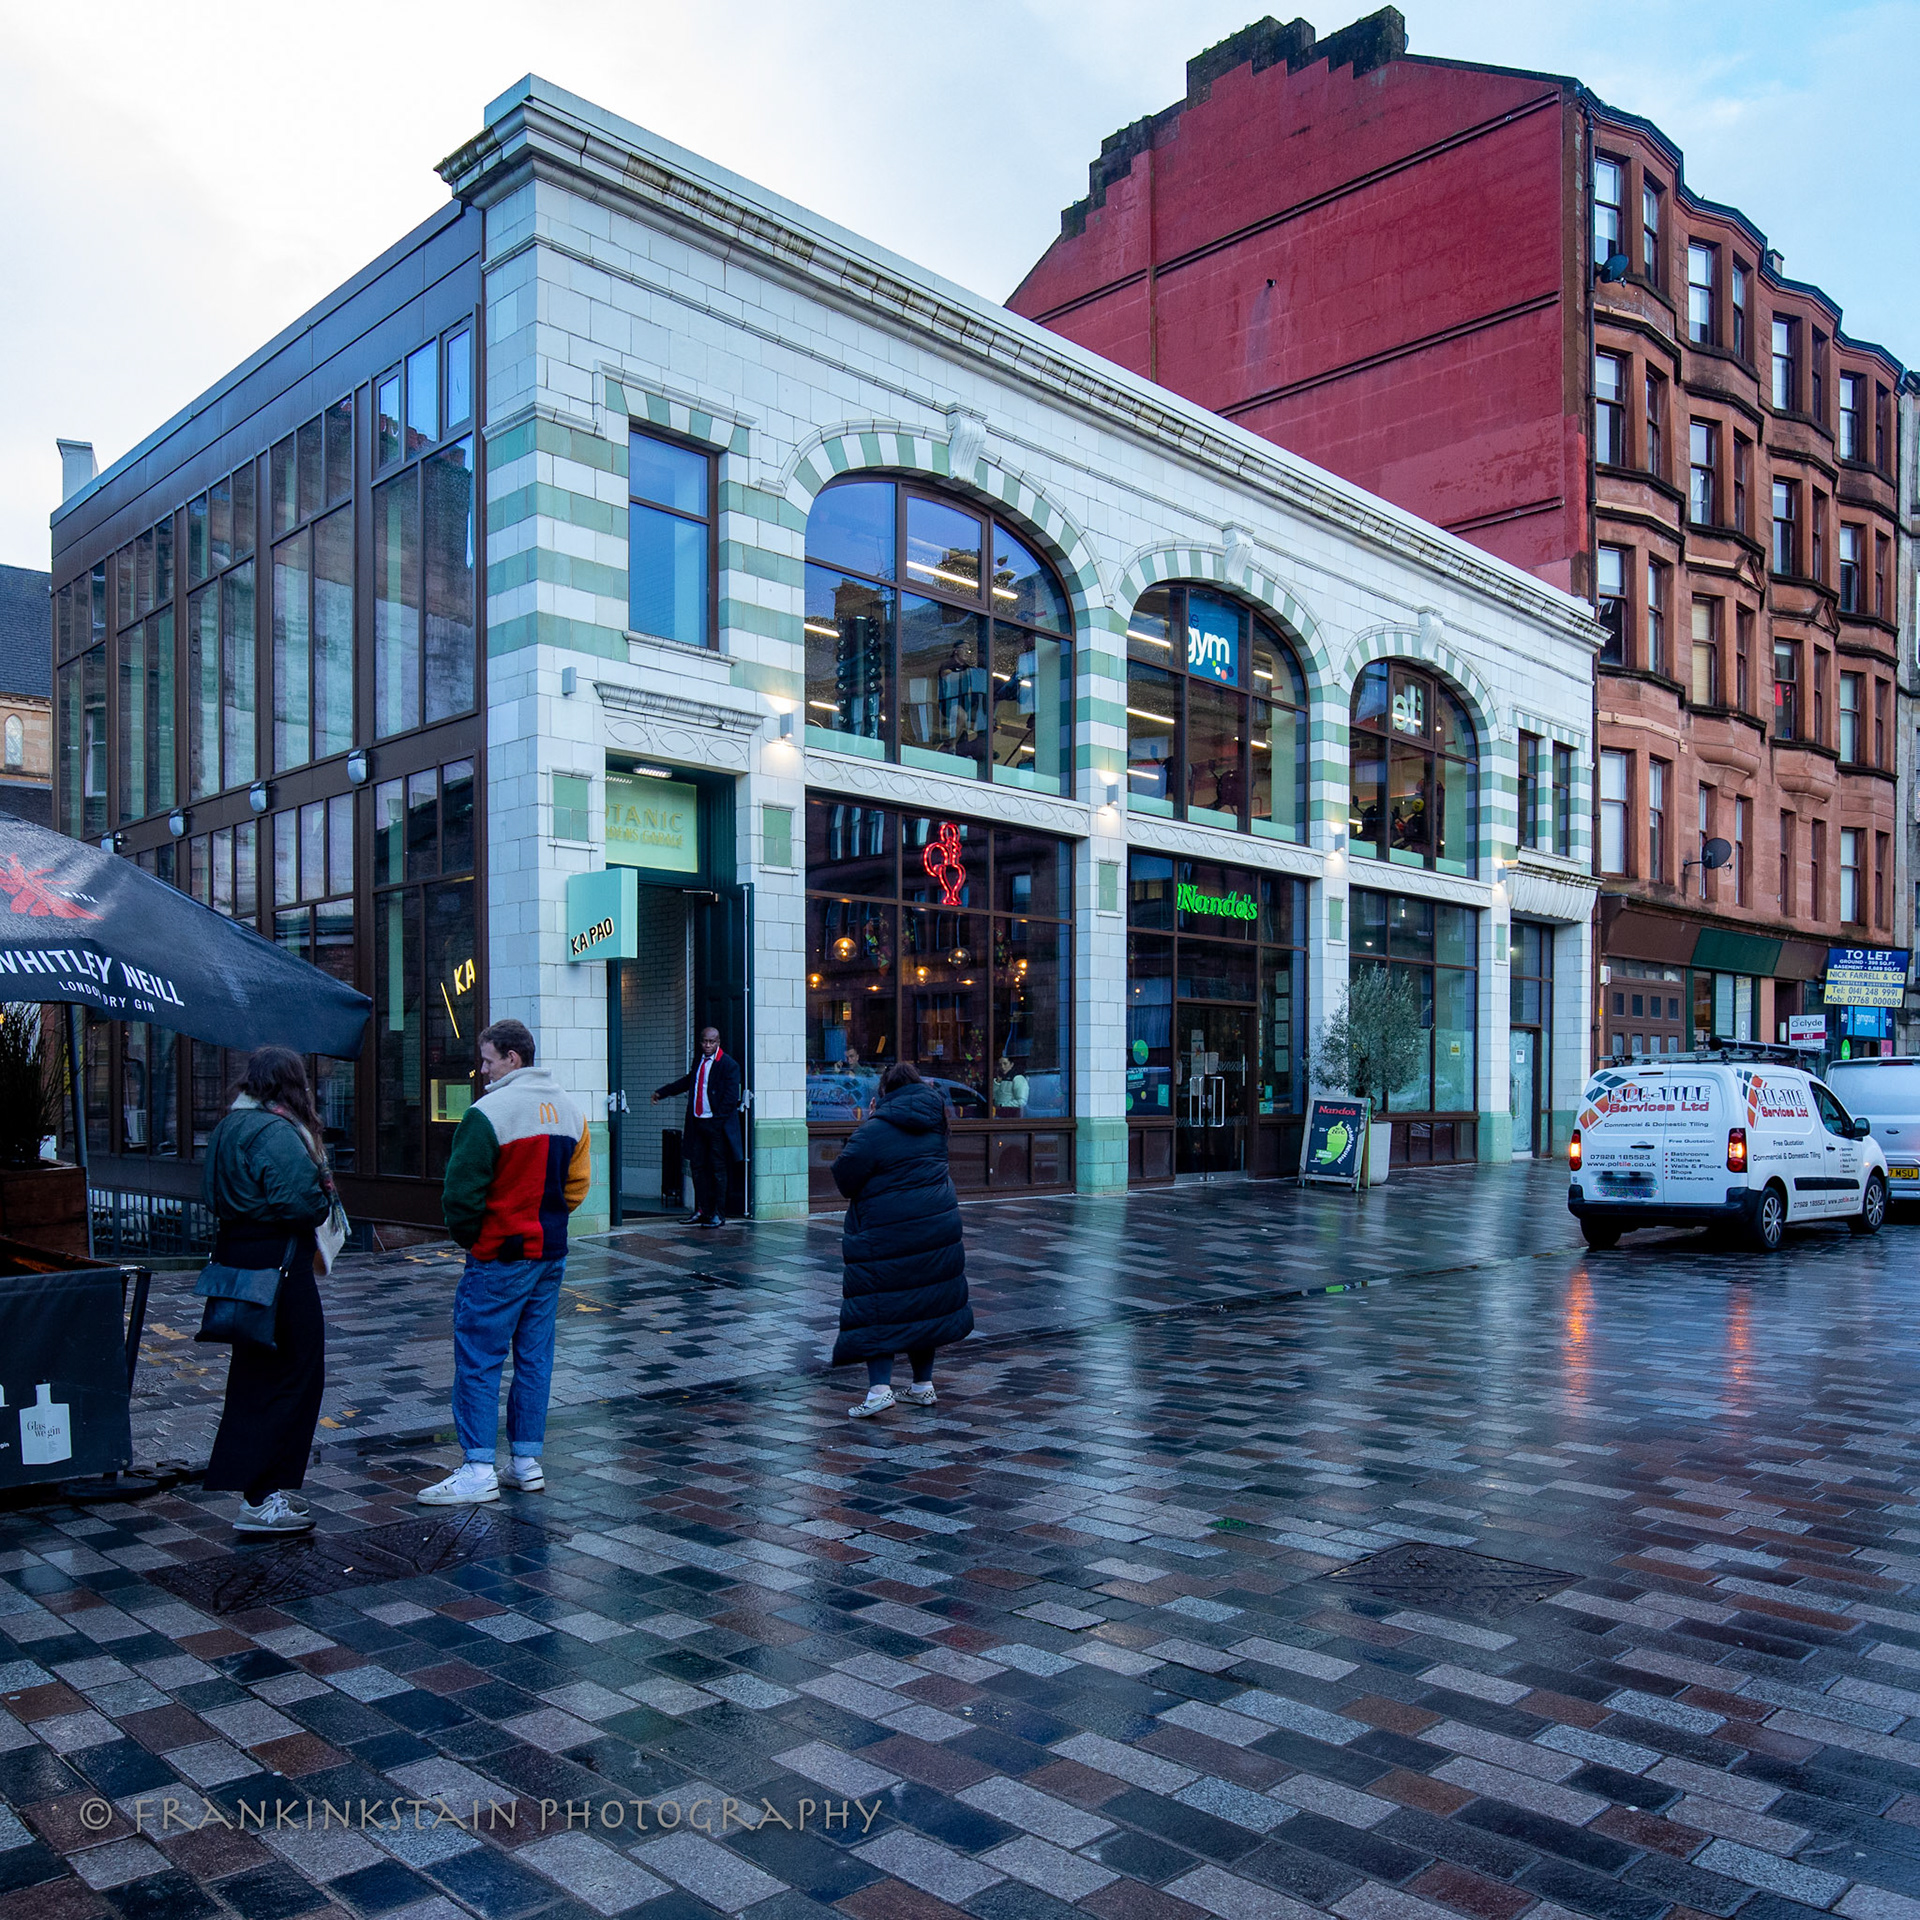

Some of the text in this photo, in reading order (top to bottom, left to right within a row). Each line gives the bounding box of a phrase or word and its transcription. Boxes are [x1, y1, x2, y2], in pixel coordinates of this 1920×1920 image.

[1188, 626, 1230, 665] gym
[1177, 883, 1258, 920] Nando's
[570, 917, 615, 956] KA PAO
[1846, 949, 1892, 961] TO LET
[454, 958, 476, 996] KA
[1849, 972, 1880, 980] FARRELL
[120, 962, 185, 1006] NEILL
[102, 994, 126, 1008] DRY
[134, 999, 155, 1013] GIN
[1826, 995, 1901, 1005] Mob: 07768 000089
[1799, 1019, 1823, 1028] clyde
[1607, 1086, 1711, 1103] POL-TILE
[1755, 1088, 1806, 1106] POL-TILE
[1318, 1105, 1356, 1116] Nando's
[1609, 1101, 1710, 1113] Services Ltd
[1761, 1106, 1809, 1117] Services Ltd
[1788, 1152, 1809, 1160] Domestic
[26, 1420, 46, 1431] Glas
[34, 1426, 60, 1438] we gin
